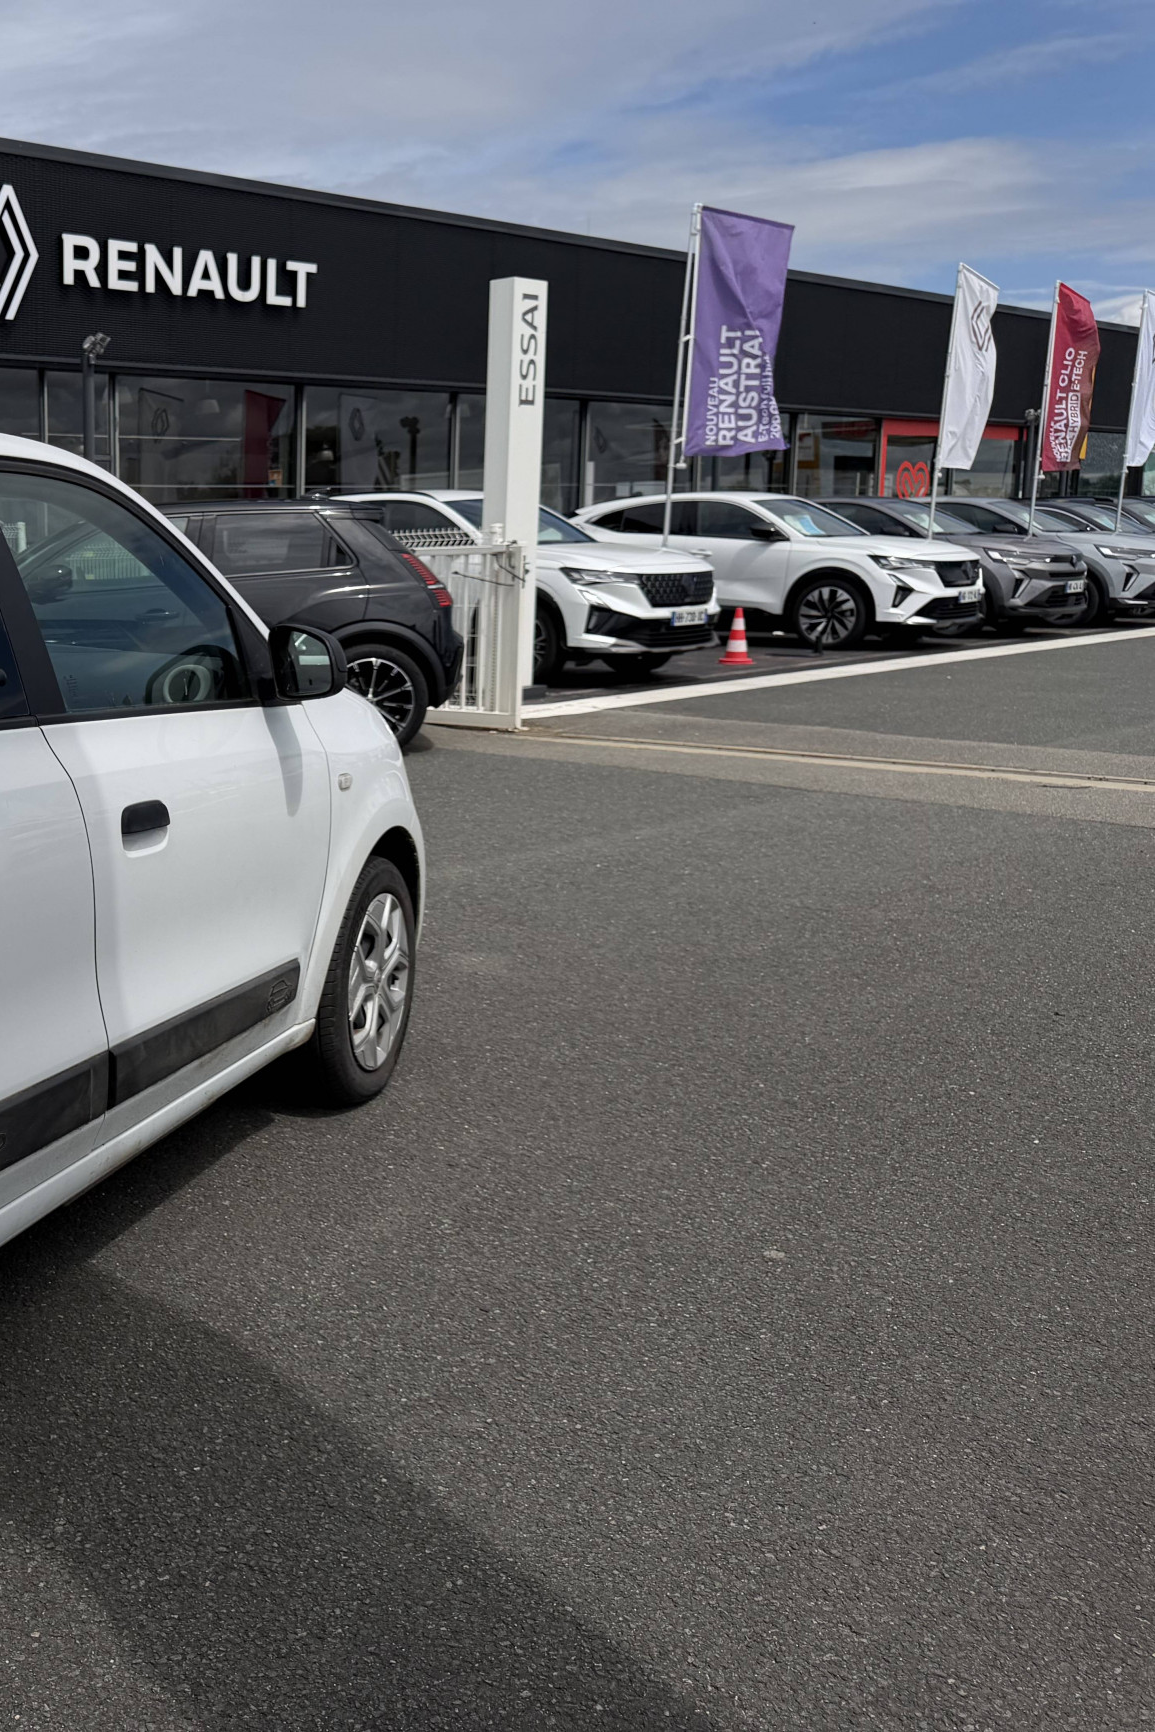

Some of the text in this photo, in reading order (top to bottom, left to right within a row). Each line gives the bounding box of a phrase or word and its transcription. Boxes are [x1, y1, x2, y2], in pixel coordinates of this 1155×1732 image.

[61, 233, 318, 308] RENAULT
[518, 293, 539, 407] ESSAI
[717, 324, 742, 446] RENAULT
[1058, 347, 1075, 387] CLIO
[1071, 350, 1088, 391] E-TECH
[704, 376, 719, 446] NOUVEAU
[1068, 394, 1079, 434] HYBRID
